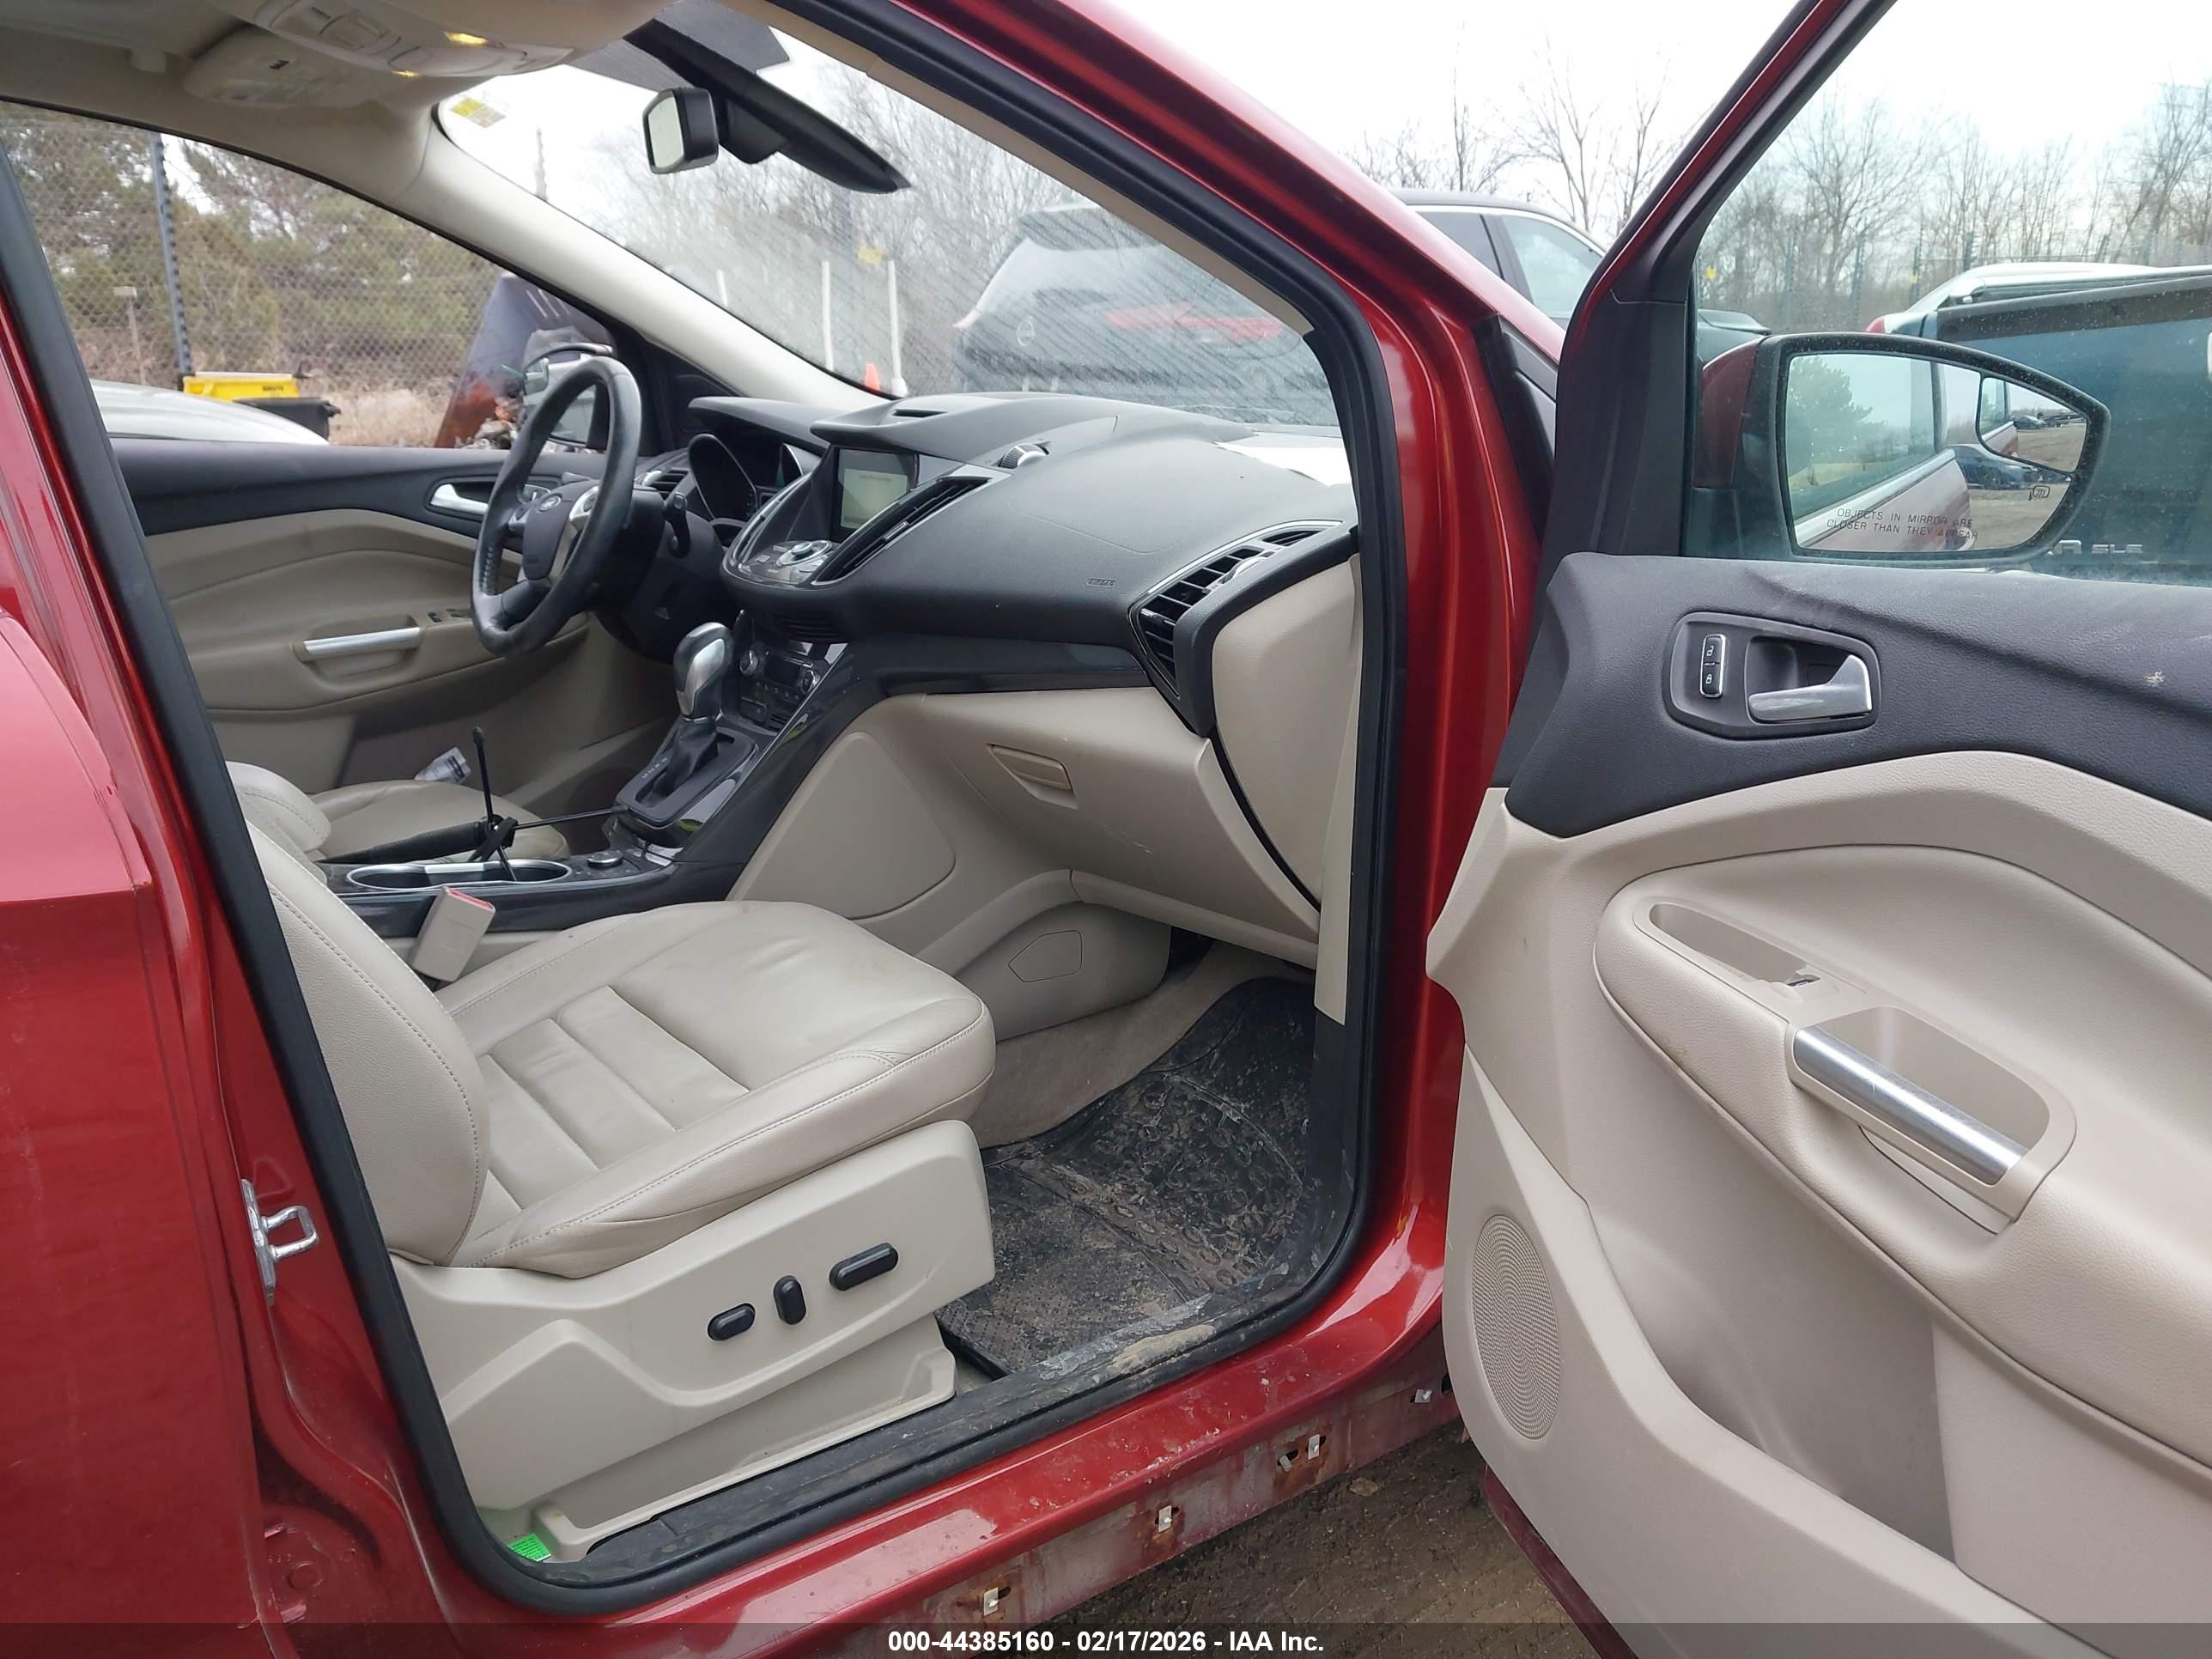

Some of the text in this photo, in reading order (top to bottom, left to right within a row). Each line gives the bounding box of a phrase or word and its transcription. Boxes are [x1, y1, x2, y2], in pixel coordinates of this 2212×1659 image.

[1837, 507, 1974, 528] OBJECTS IN MIRROR ARE
[1826, 519, 1978, 540] CLOSER THAN THEY APPEAR
[2091, 544, 2143, 555] SLE
